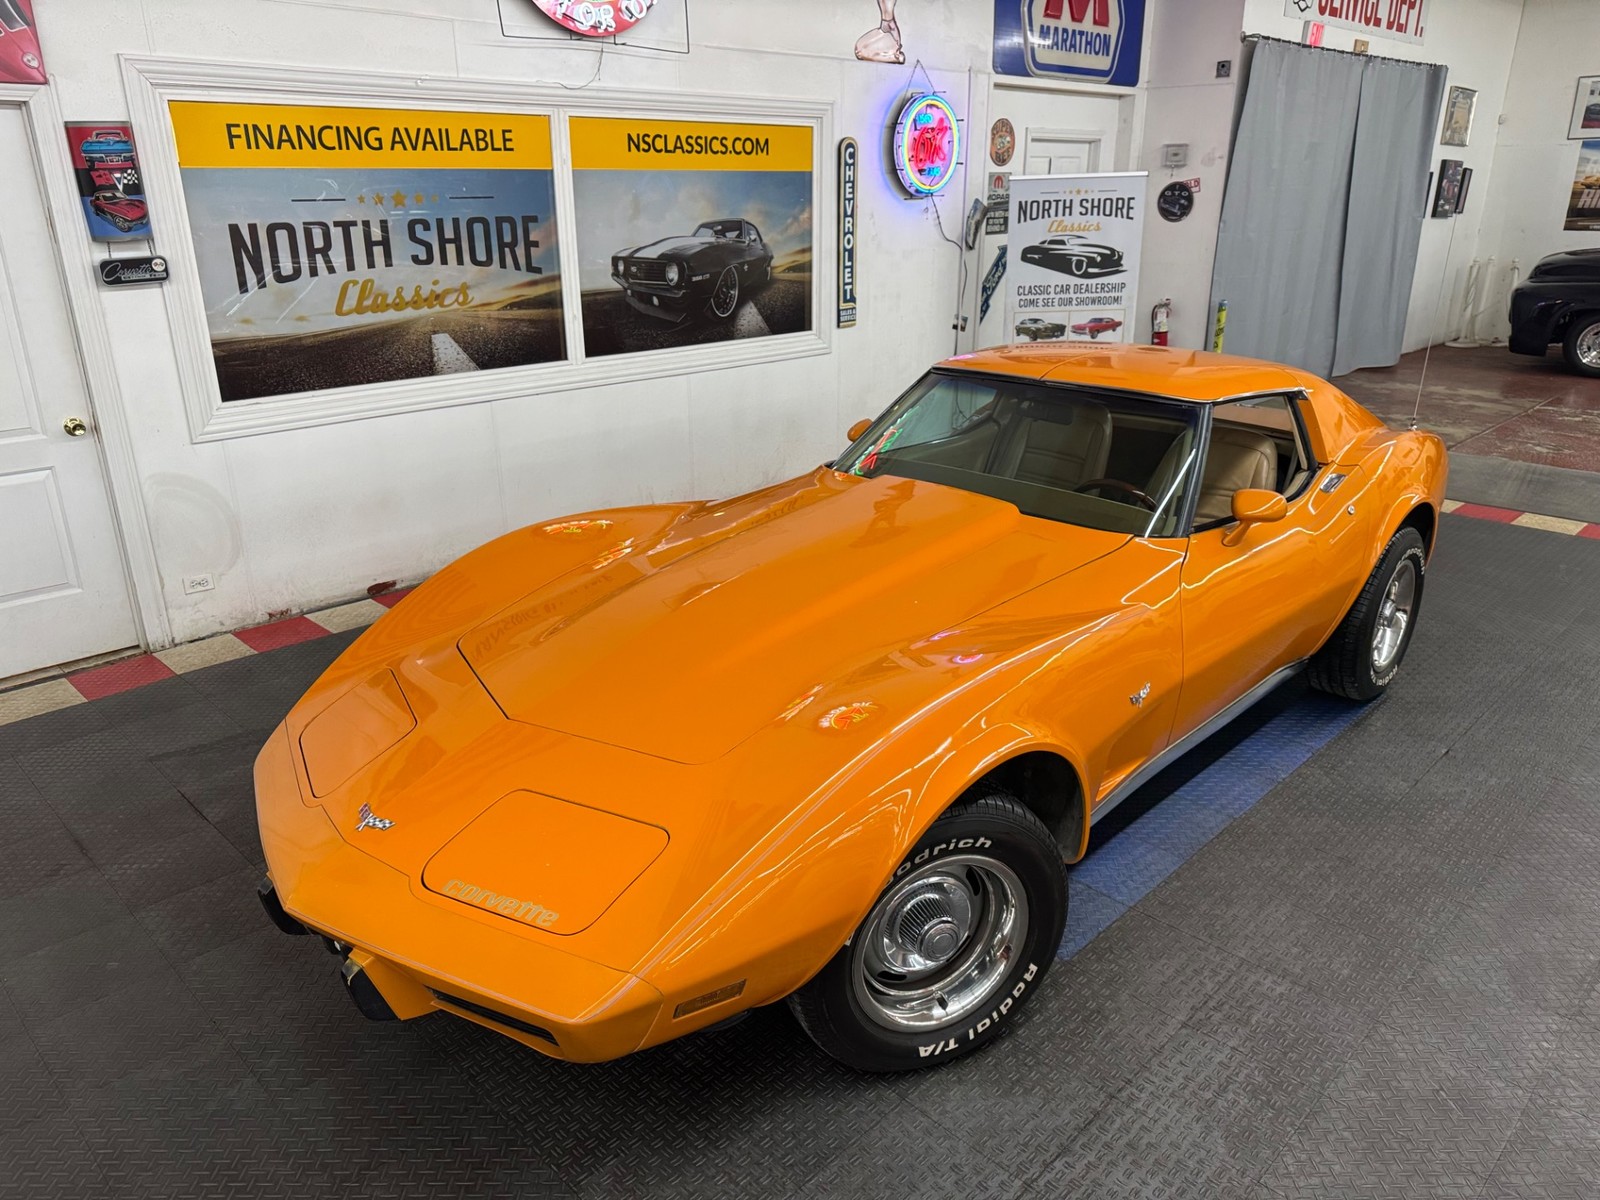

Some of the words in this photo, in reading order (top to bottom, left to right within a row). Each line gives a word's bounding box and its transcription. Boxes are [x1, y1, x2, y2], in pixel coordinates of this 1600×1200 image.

[1039, 24, 1111, 57] MARATHON
[225, 123, 383, 151] FINANCING
[390, 127, 515, 152] AVAILABLE
[627, 132, 769, 156] NSCLASSICS.COM
[844, 147, 855, 300] CHEVROLET
[1017, 199, 1073, 224] NORTH
[1079, 197, 1135, 220] SHORE
[1047, 219, 1102, 233] Classics
[228, 219, 393, 294] NORTH
[407, 215, 543, 274] SHORE
[335, 278, 474, 316] Classics
[1017, 285, 1051, 296] CLASSIC
[1054, 284, 1070, 295] CAR
[1073, 282, 1126, 295] DEALERSHIP
[1018, 298, 1040, 308] COME
[1042, 298, 1056, 307] SEE
[1058, 297, 1073, 307] OUR
[1075, 295, 1122, 306] SHOWROOM!
[968, 962, 1038, 1040] Radial
[918, 1037, 958, 1058] T/A
